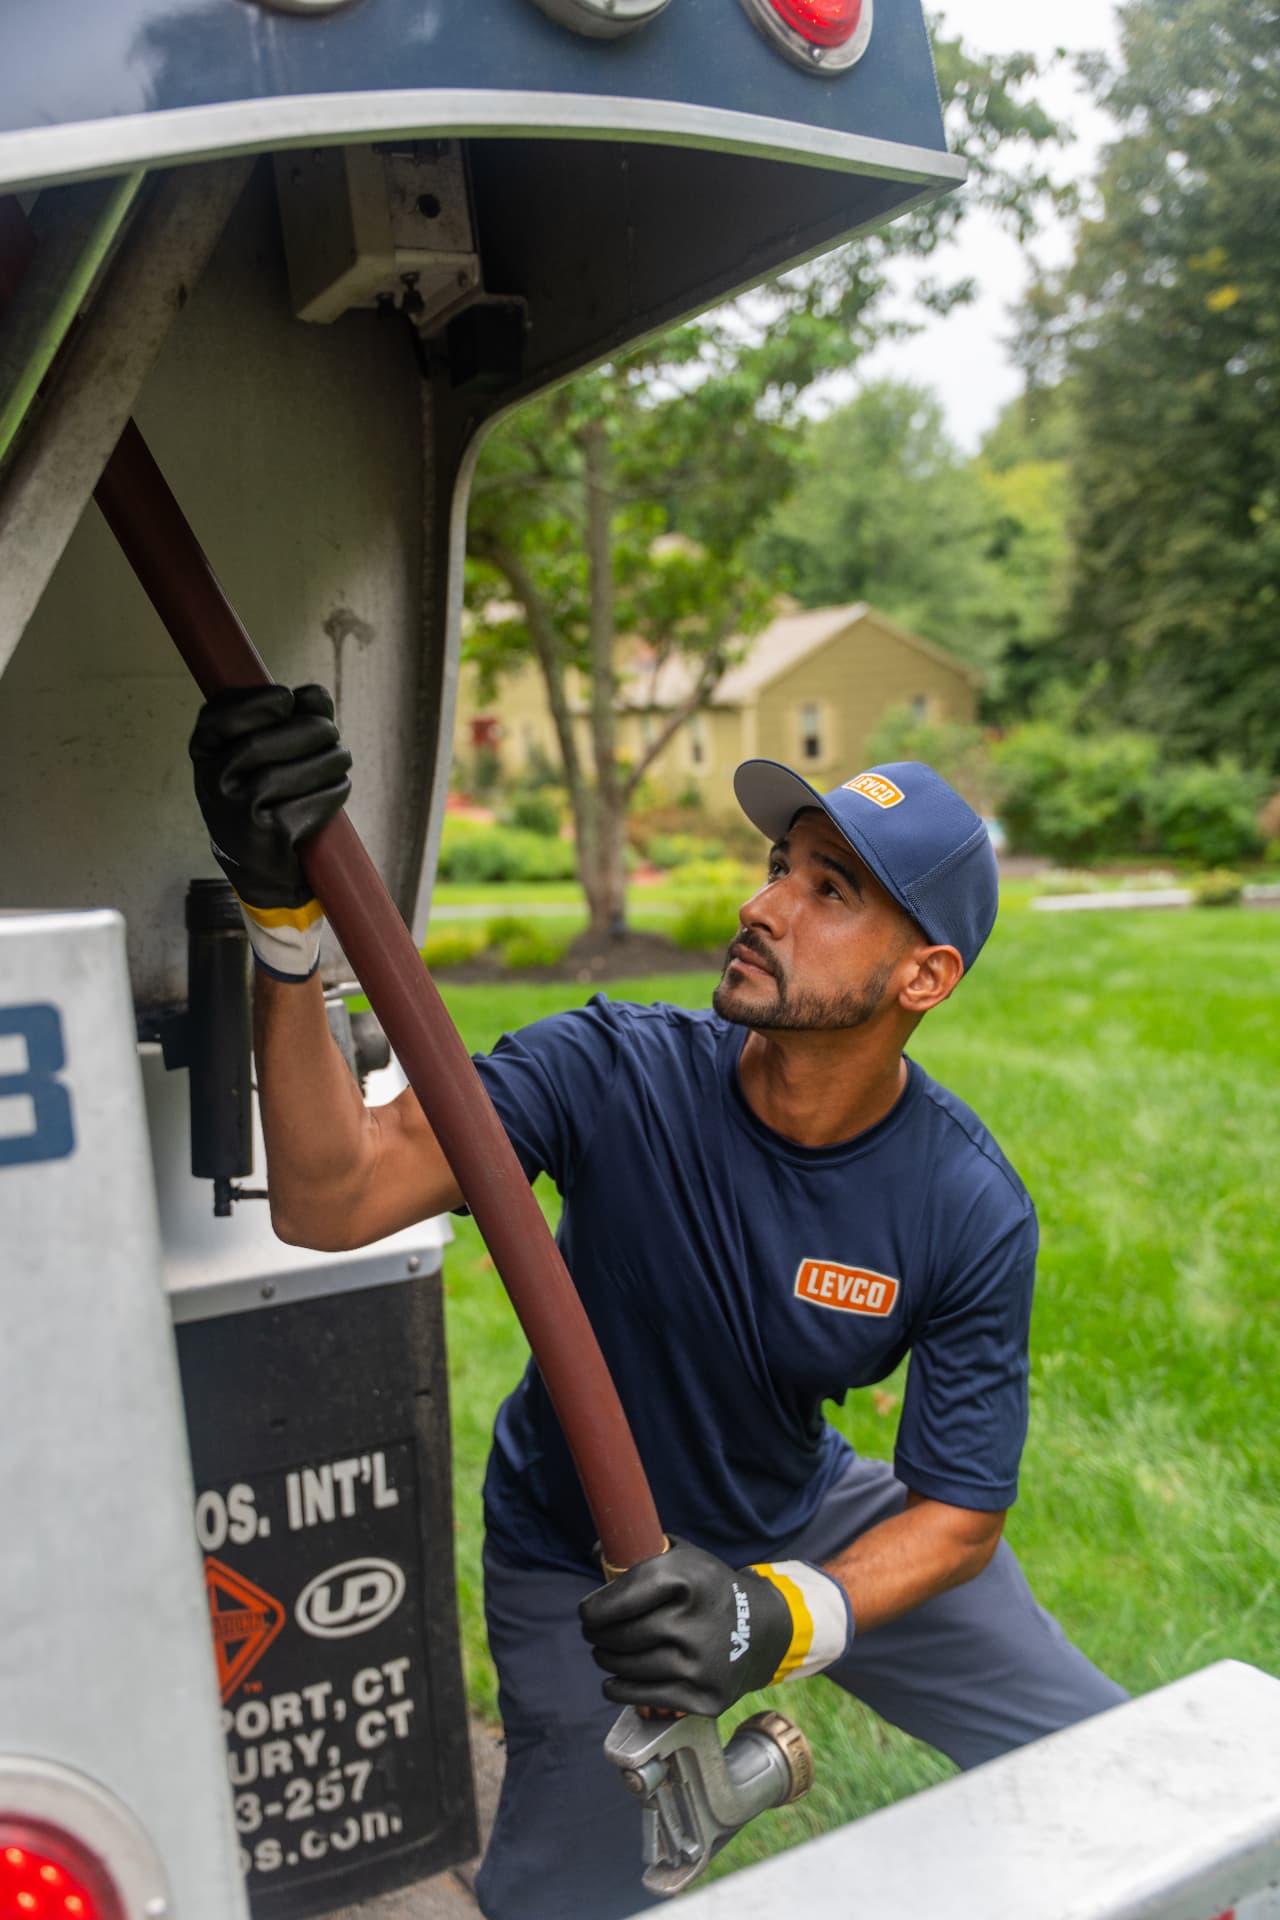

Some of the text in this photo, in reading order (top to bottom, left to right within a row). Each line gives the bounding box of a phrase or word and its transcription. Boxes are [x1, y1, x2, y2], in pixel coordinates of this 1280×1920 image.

[806, 1267, 887, 1309] LEVCO
[286, 1451, 399, 1531] INT'L
[311, 1571, 393, 1625] UD
[352, 1656, 411, 1706] CT
[355, 1699, 414, 1748] CT
